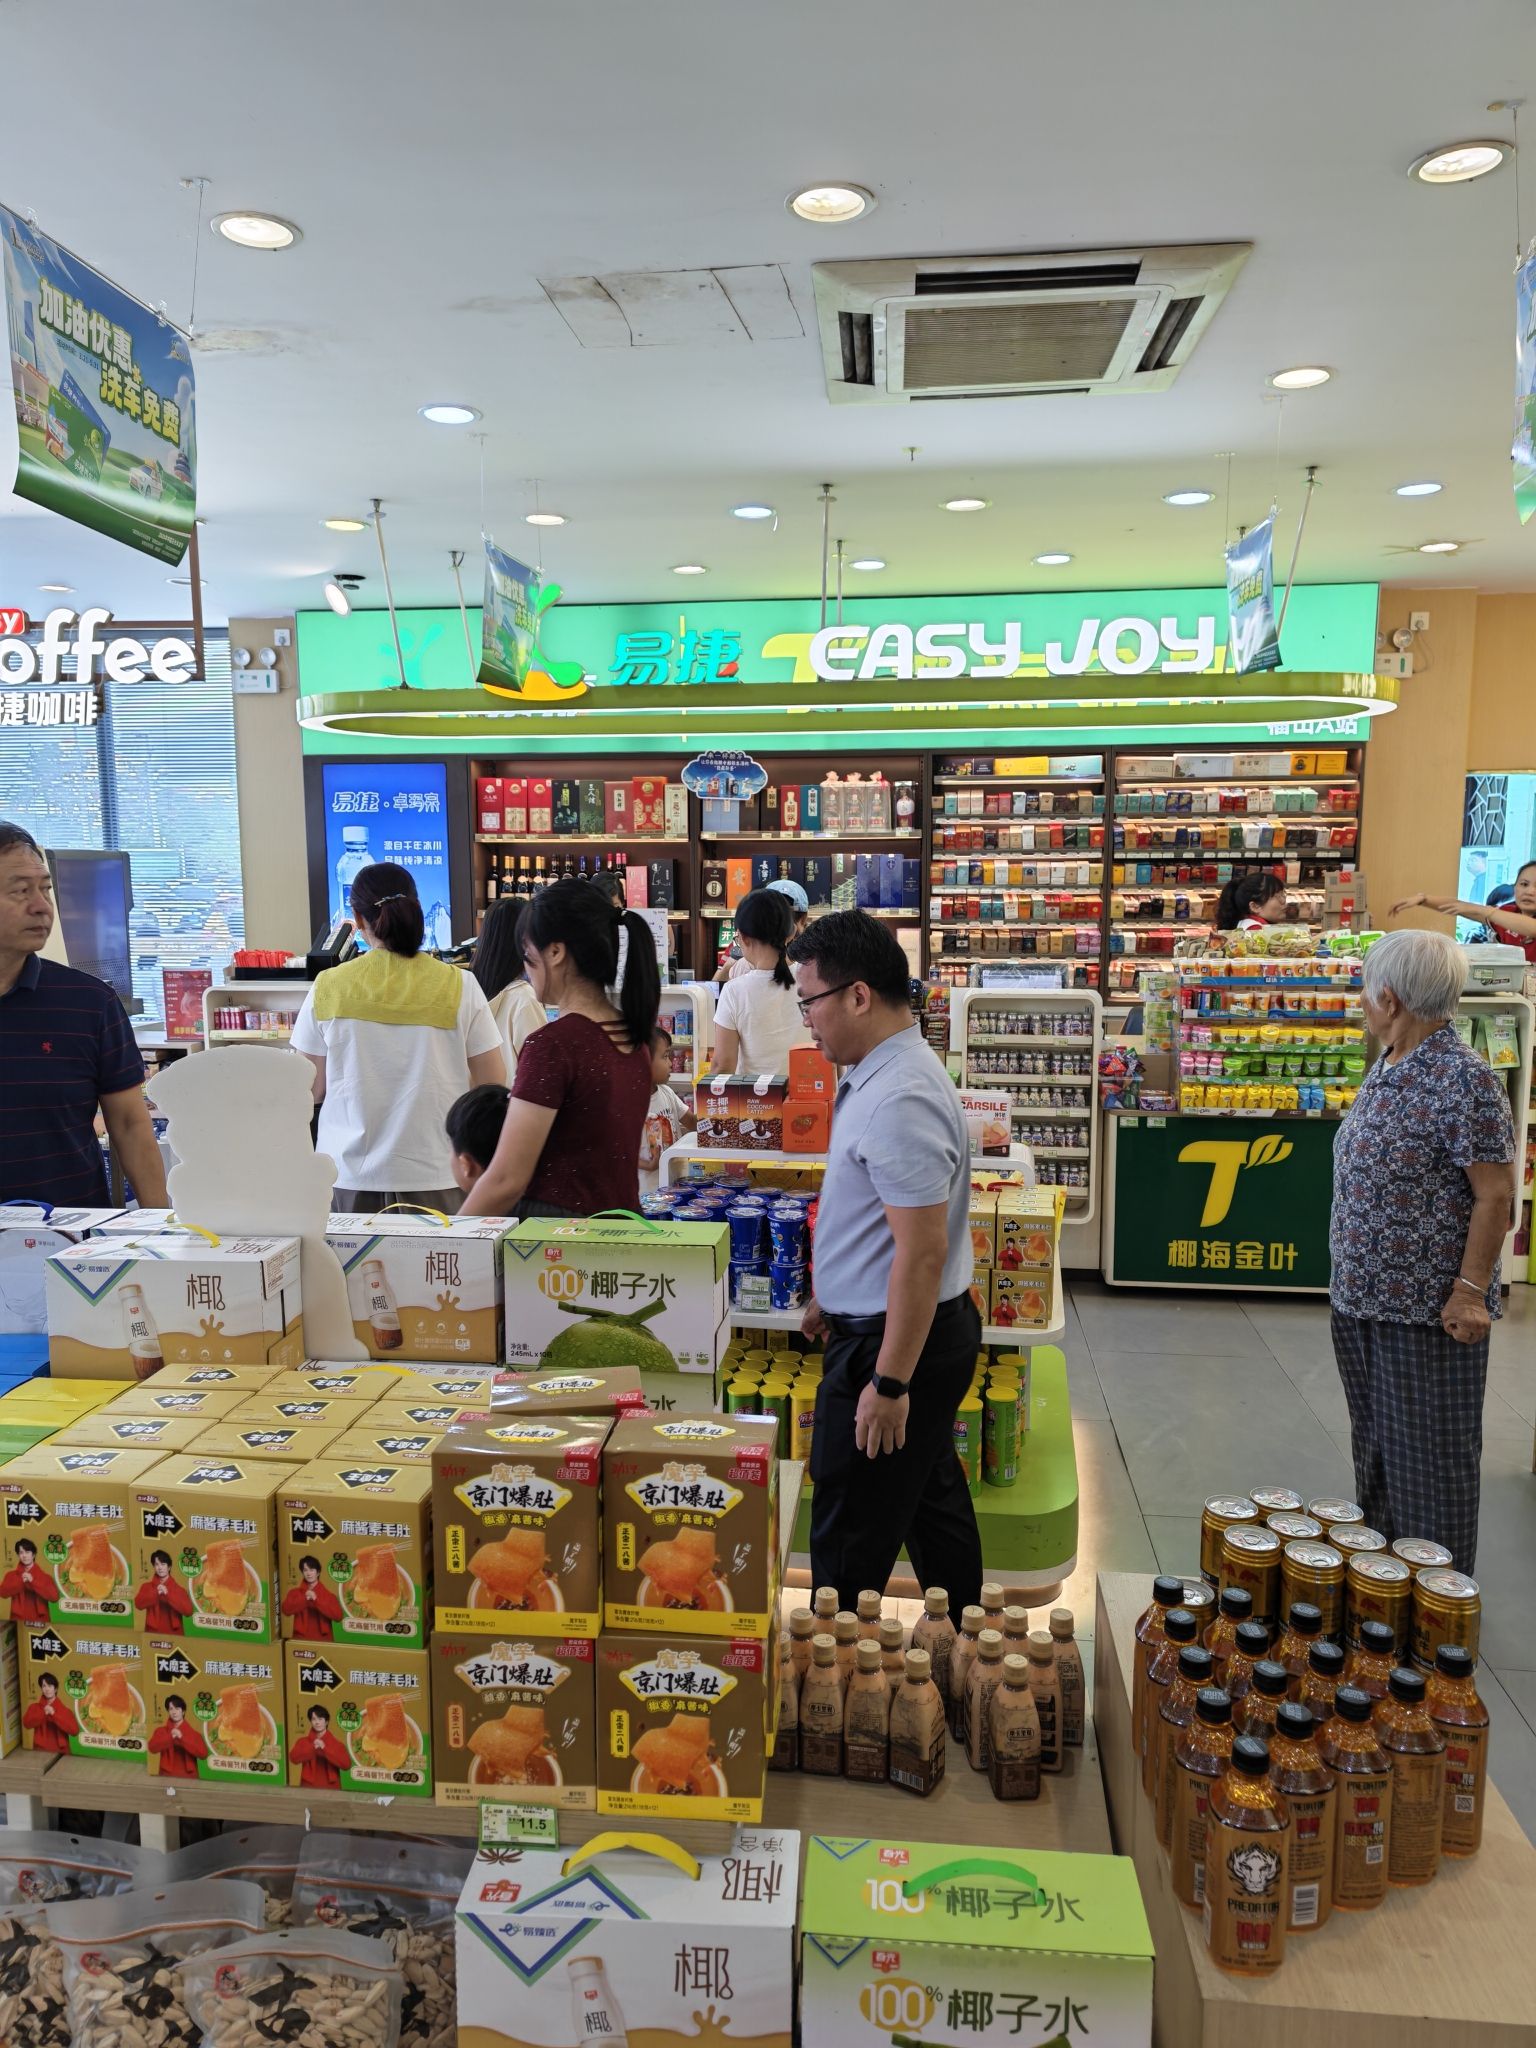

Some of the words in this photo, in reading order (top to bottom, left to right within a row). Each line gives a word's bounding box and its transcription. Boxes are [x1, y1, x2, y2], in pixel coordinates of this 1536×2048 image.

[41, 278, 132, 372] 加油优惠
[101, 364, 180, 445] 洗车免费
[610, 628, 743, 686] 易捷
[809, 622, 1021, 681] EASY
[1044, 616, 1215, 677] JOY
[383, 840, 442, 851] 源自千年冰川
[1168, 1239, 1299, 1271] 椰海金叶
[425, 1250, 462, 1287] 椰
[186, 1273, 226, 1311] 椰
[542, 1269, 588, 1297] 100%
[590, 1270, 677, 1300] 椰子水
[371, 1296, 389, 1311] 椰
[131, 1321, 150, 1339] 椰
[510, 1343, 530, 1351] 净含量:
[119, 1421, 161, 1435] 大魔王
[248, 1430, 290, 1445] 大魔王
[383, 1437, 424, 1451] 大魔王
[66, 1453, 111, 1468] 大魔王
[344, 1469, 389, 1485] 大魔王
[491, 1462, 536, 1483] 魔芋
[660, 1461, 708, 1483] 魔芋
[467, 1485, 556, 1510] 京门爆肚
[638, 1484, 727, 1510] 京门爆肚
[8, 1503, 40, 1517] 大魔王
[55, 1502, 124, 1519] 麻酱素毛肚
[144, 1513, 176, 1529] 大魔王
[190, 1515, 258, 1534] 麻酱素毛肚
[293, 1519, 325, 1534] 大魔王
[340, 1519, 411, 1538] 麻酱素毛肚
[451, 1530, 461, 1569] 正宗二八酱
[621, 1528, 631, 1567] 正宗二八酱
[31, 1637, 62, 1653] 大魔王
[76, 1640, 141, 1659] 麻酱素毛肚
[490, 1641, 535, 1662] 魔芋
[158, 1659, 190, 1674] 大魔王
[655, 1649, 702, 1670] 魔芋
[205, 1660, 273, 1679] 麻酱素毛肚
[301, 1668, 334, 1683] 大魔王
[349, 1670, 420, 1688] 麻酱素毛肚
[467, 1663, 555, 1687] 京门爆肚
[633, 1671, 721, 1697] 京门爆肚
[451, 1707, 461, 1746] 正宗二八酱
[615, 1714, 625, 1753] 正宗二八酱
[1346, 1779, 1388, 1792] PREDATOR
[519, 1817, 547, 1830] 11.5
[739, 1835, 784, 1853] 净含
[881, 1849, 907, 1859] 春光
[721, 1856, 783, 1904] 椰
[945, 1885, 1086, 1924] 椰子水
[1227, 1899, 1280, 1913] PREDATOR
[522, 1926, 557, 1938] 易臻选
[875, 1952, 897, 1962] 春光
[674, 1943, 734, 2000] 椰
[863, 1984, 944, 2027] 100%
[946, 1988, 1090, 2035] 椰子水
[584, 2010, 612, 2033] 椰
